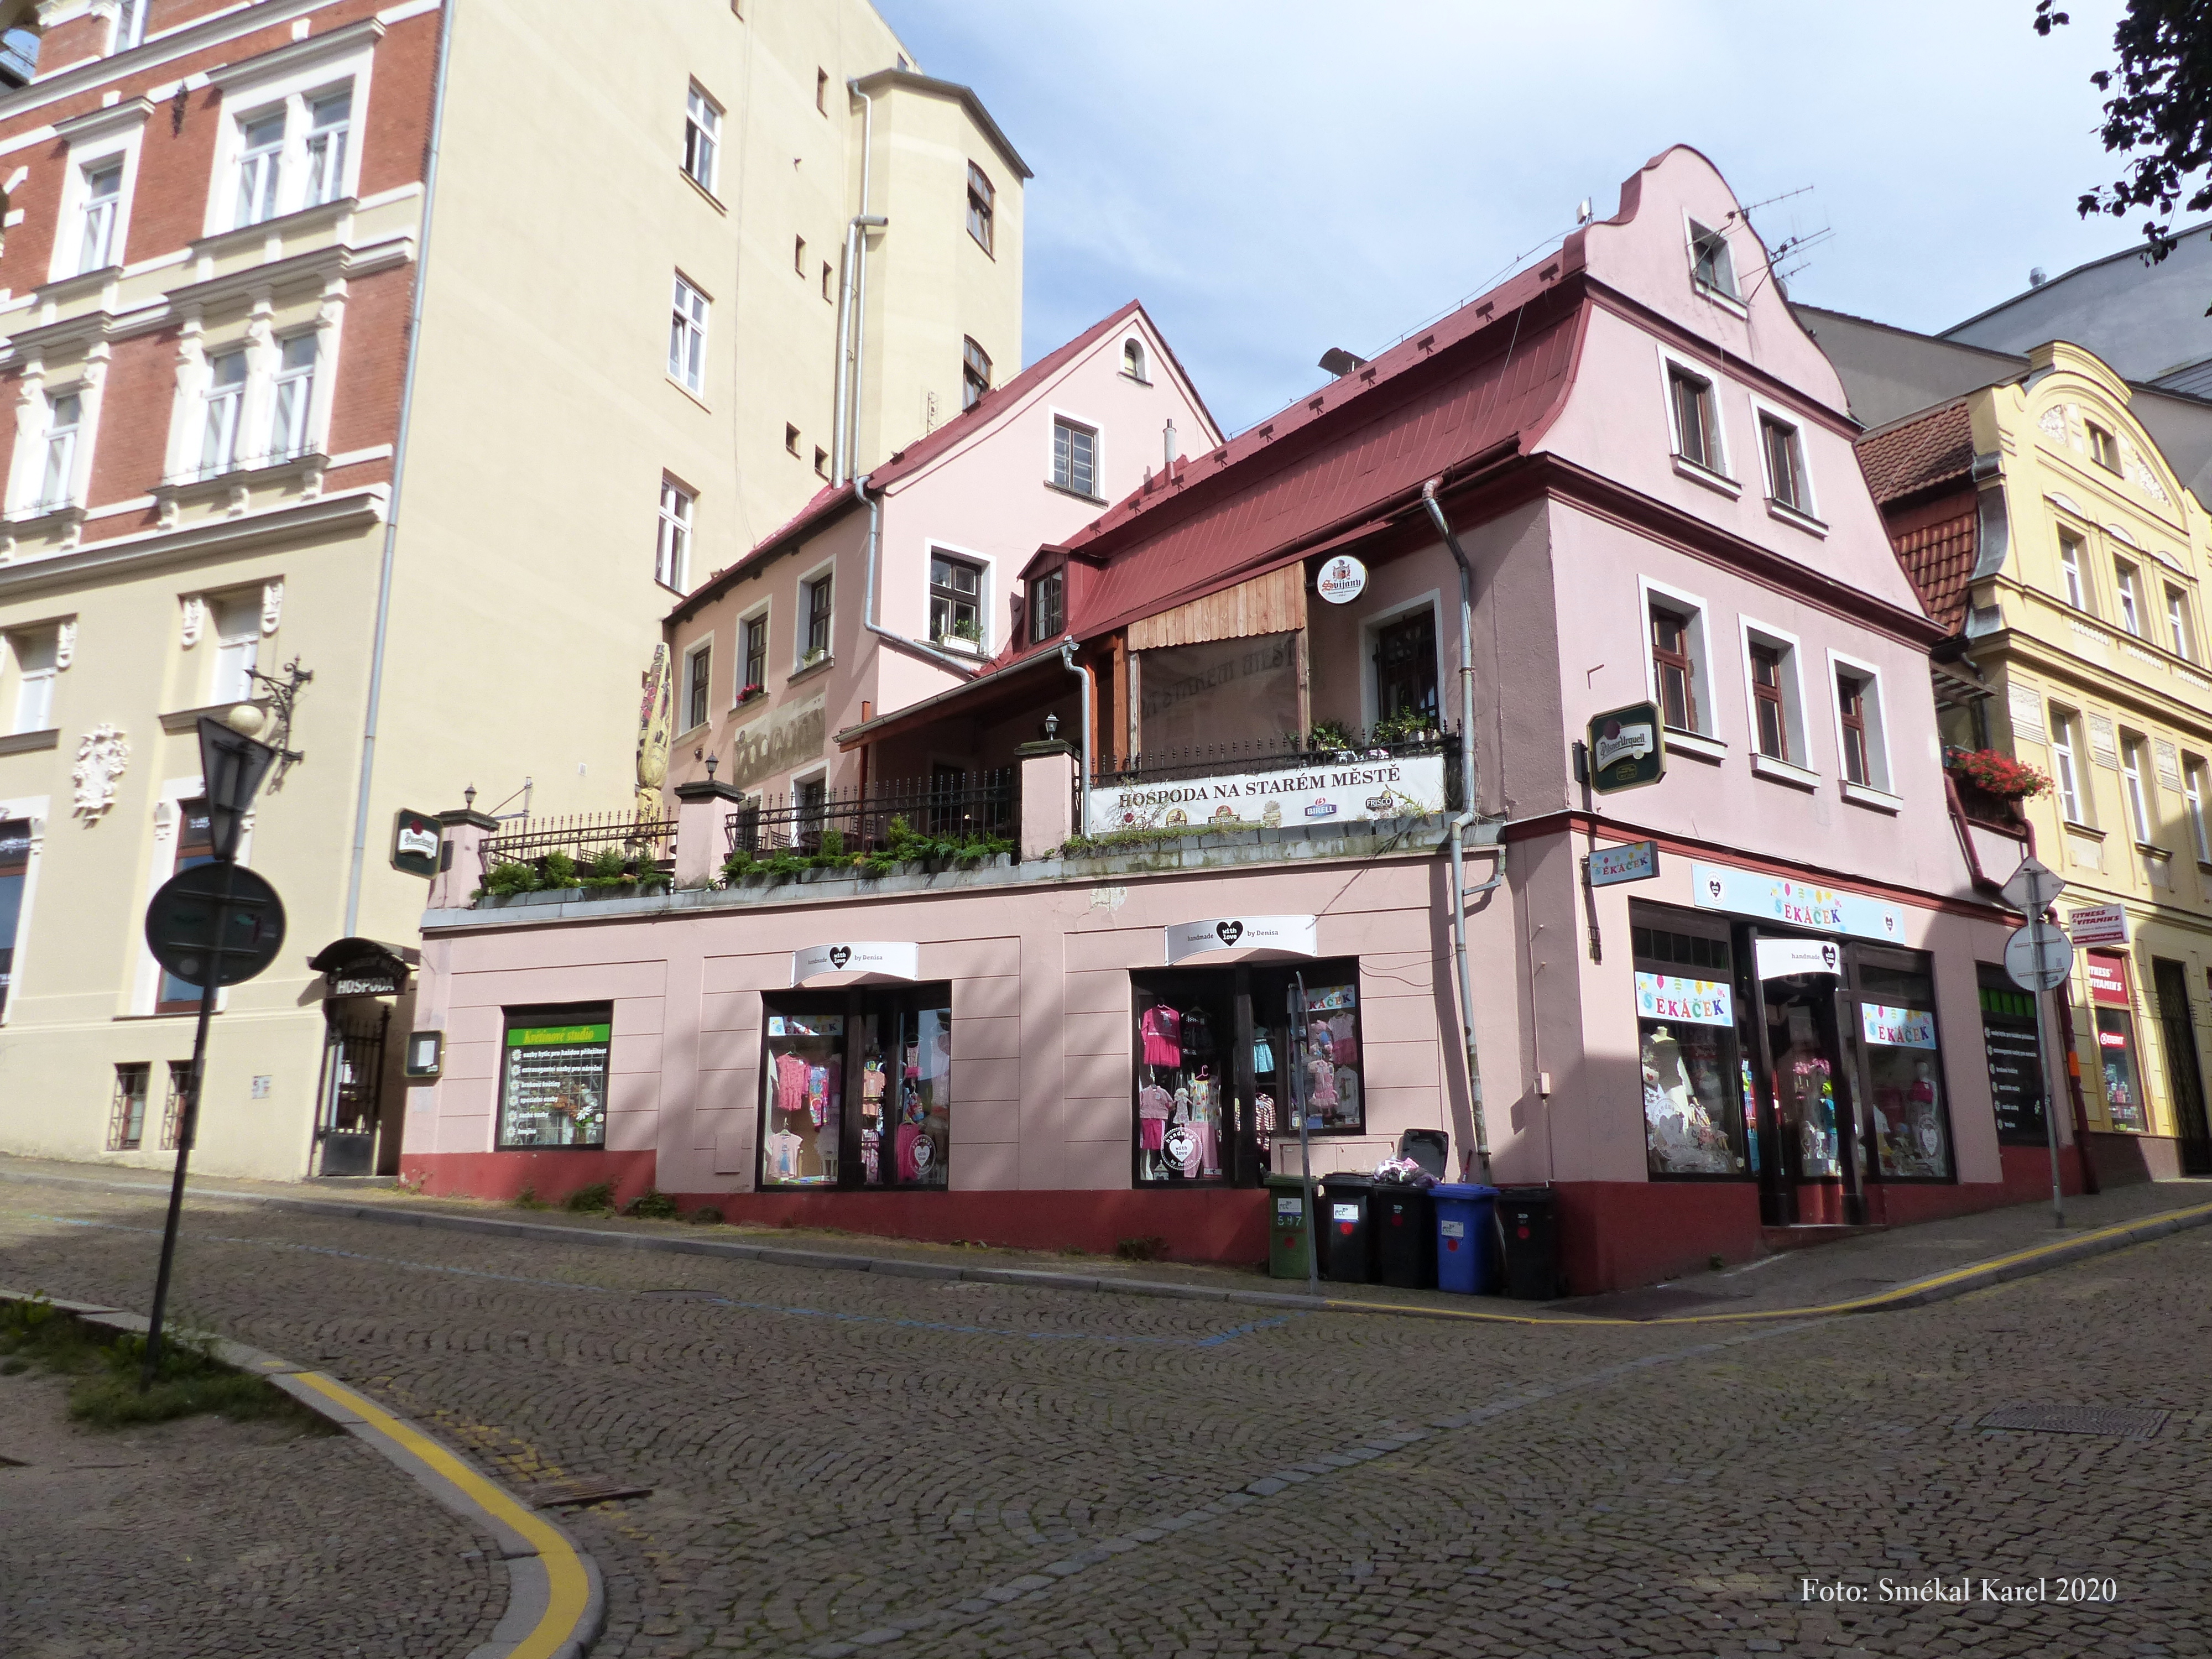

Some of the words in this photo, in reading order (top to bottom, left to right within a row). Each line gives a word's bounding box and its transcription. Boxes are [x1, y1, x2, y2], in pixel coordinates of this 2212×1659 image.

[1322, 579, 1361, 592] Svijany
[1620, 733, 1645, 749] Urquell
[1119, 787, 1209, 808] HOSPODA
[1214, 784, 1240, 799] NA
[1246, 772, 1326, 796] STARÉM
[1331, 763, 1400, 787] MĚSTĚ
[1366, 798, 1391, 807] FRISCO
[1307, 806, 1334, 815] BIRELL
[1775, 898, 1841, 925] SEKÁČEK
[2072, 910, 2106, 919] FITNESS
[1187, 933, 1214, 942] handmade
[336, 976, 395, 995] HOSPODA
[1309, 993, 1352, 1010] KÁČEK
[1644, 992, 1724, 1019] SEKÁČEK
[567, 1026, 594, 1041] studio
[1869, 1022, 1929, 1043] SEKÁČEK
[1166, 1130, 1196, 1144] handmade
